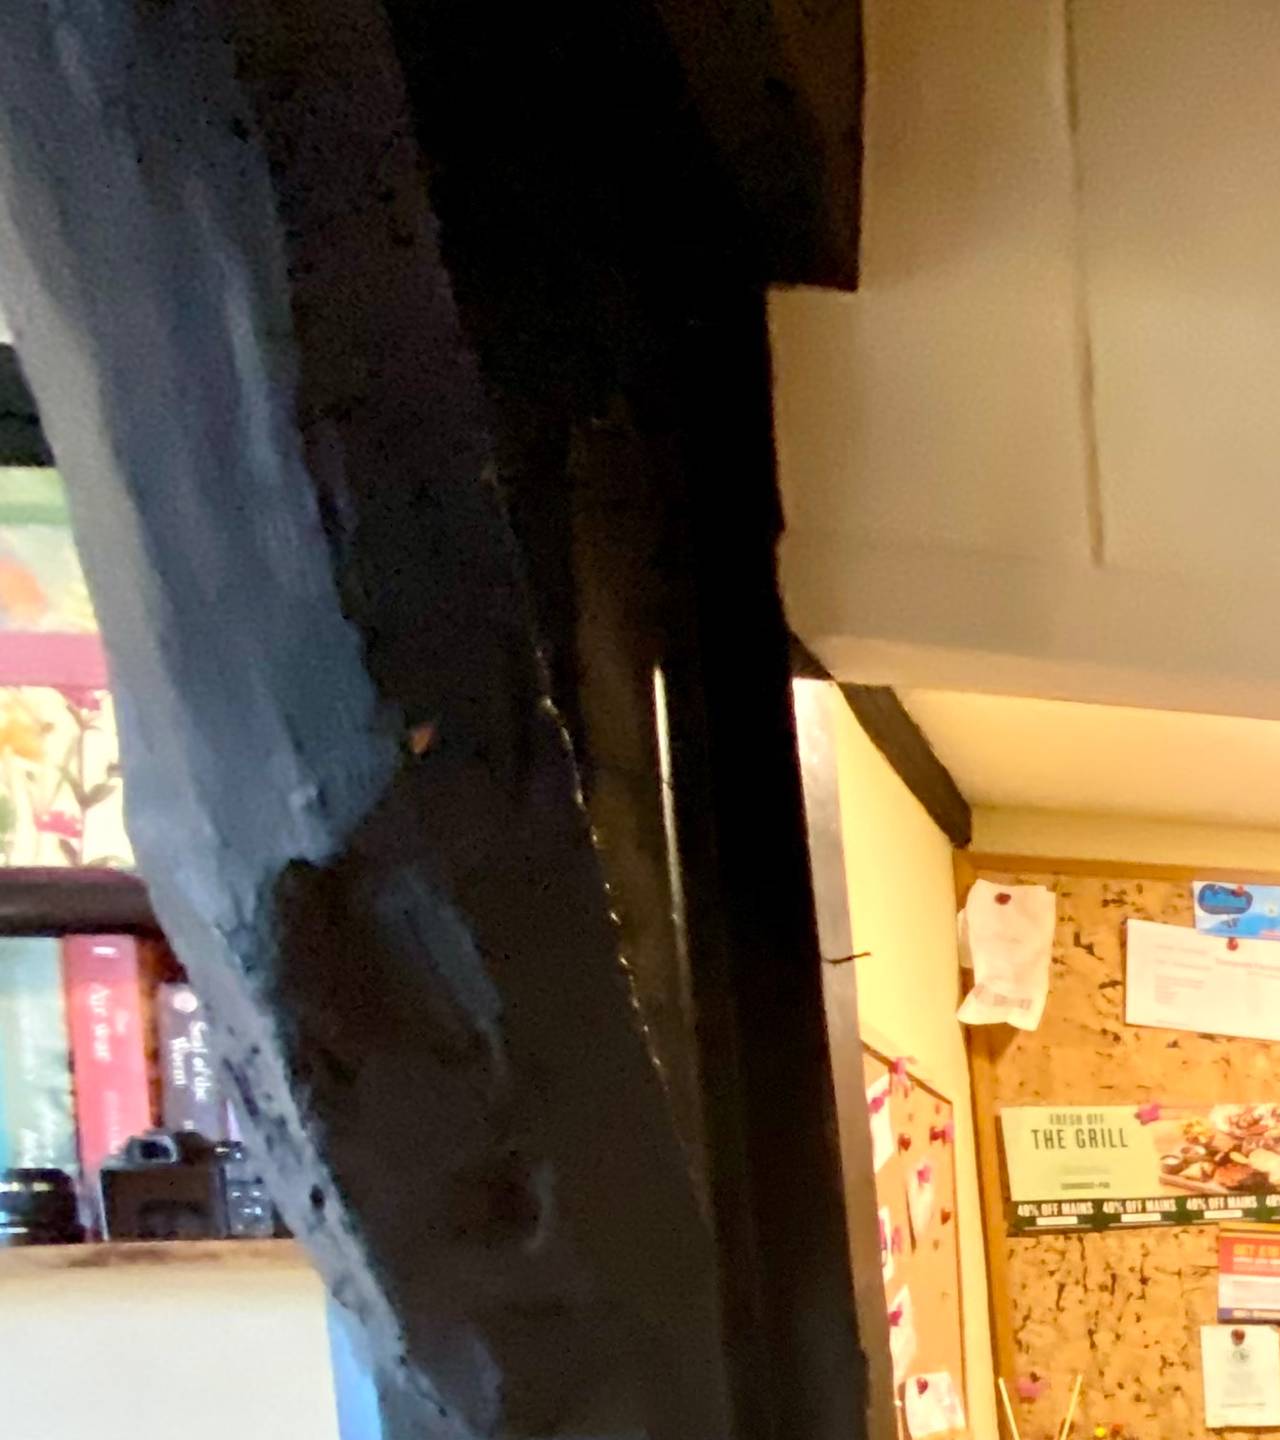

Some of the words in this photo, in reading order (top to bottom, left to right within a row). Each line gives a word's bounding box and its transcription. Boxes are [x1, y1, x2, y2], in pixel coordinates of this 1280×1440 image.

[1030, 1128, 1067, 1151] THE
[1074, 1127, 1129, 1150] GRILL
[1040, 1202, 1059, 1216] OFF
[1061, 1201, 1094, 1215] MAINS
[1124, 1199, 1142, 1213] OFF
[1144, 1198, 1177, 1212] MAINS
[1207, 1196, 1225, 1210] OFF
[1227, 1195, 1258, 1209] MAINS
